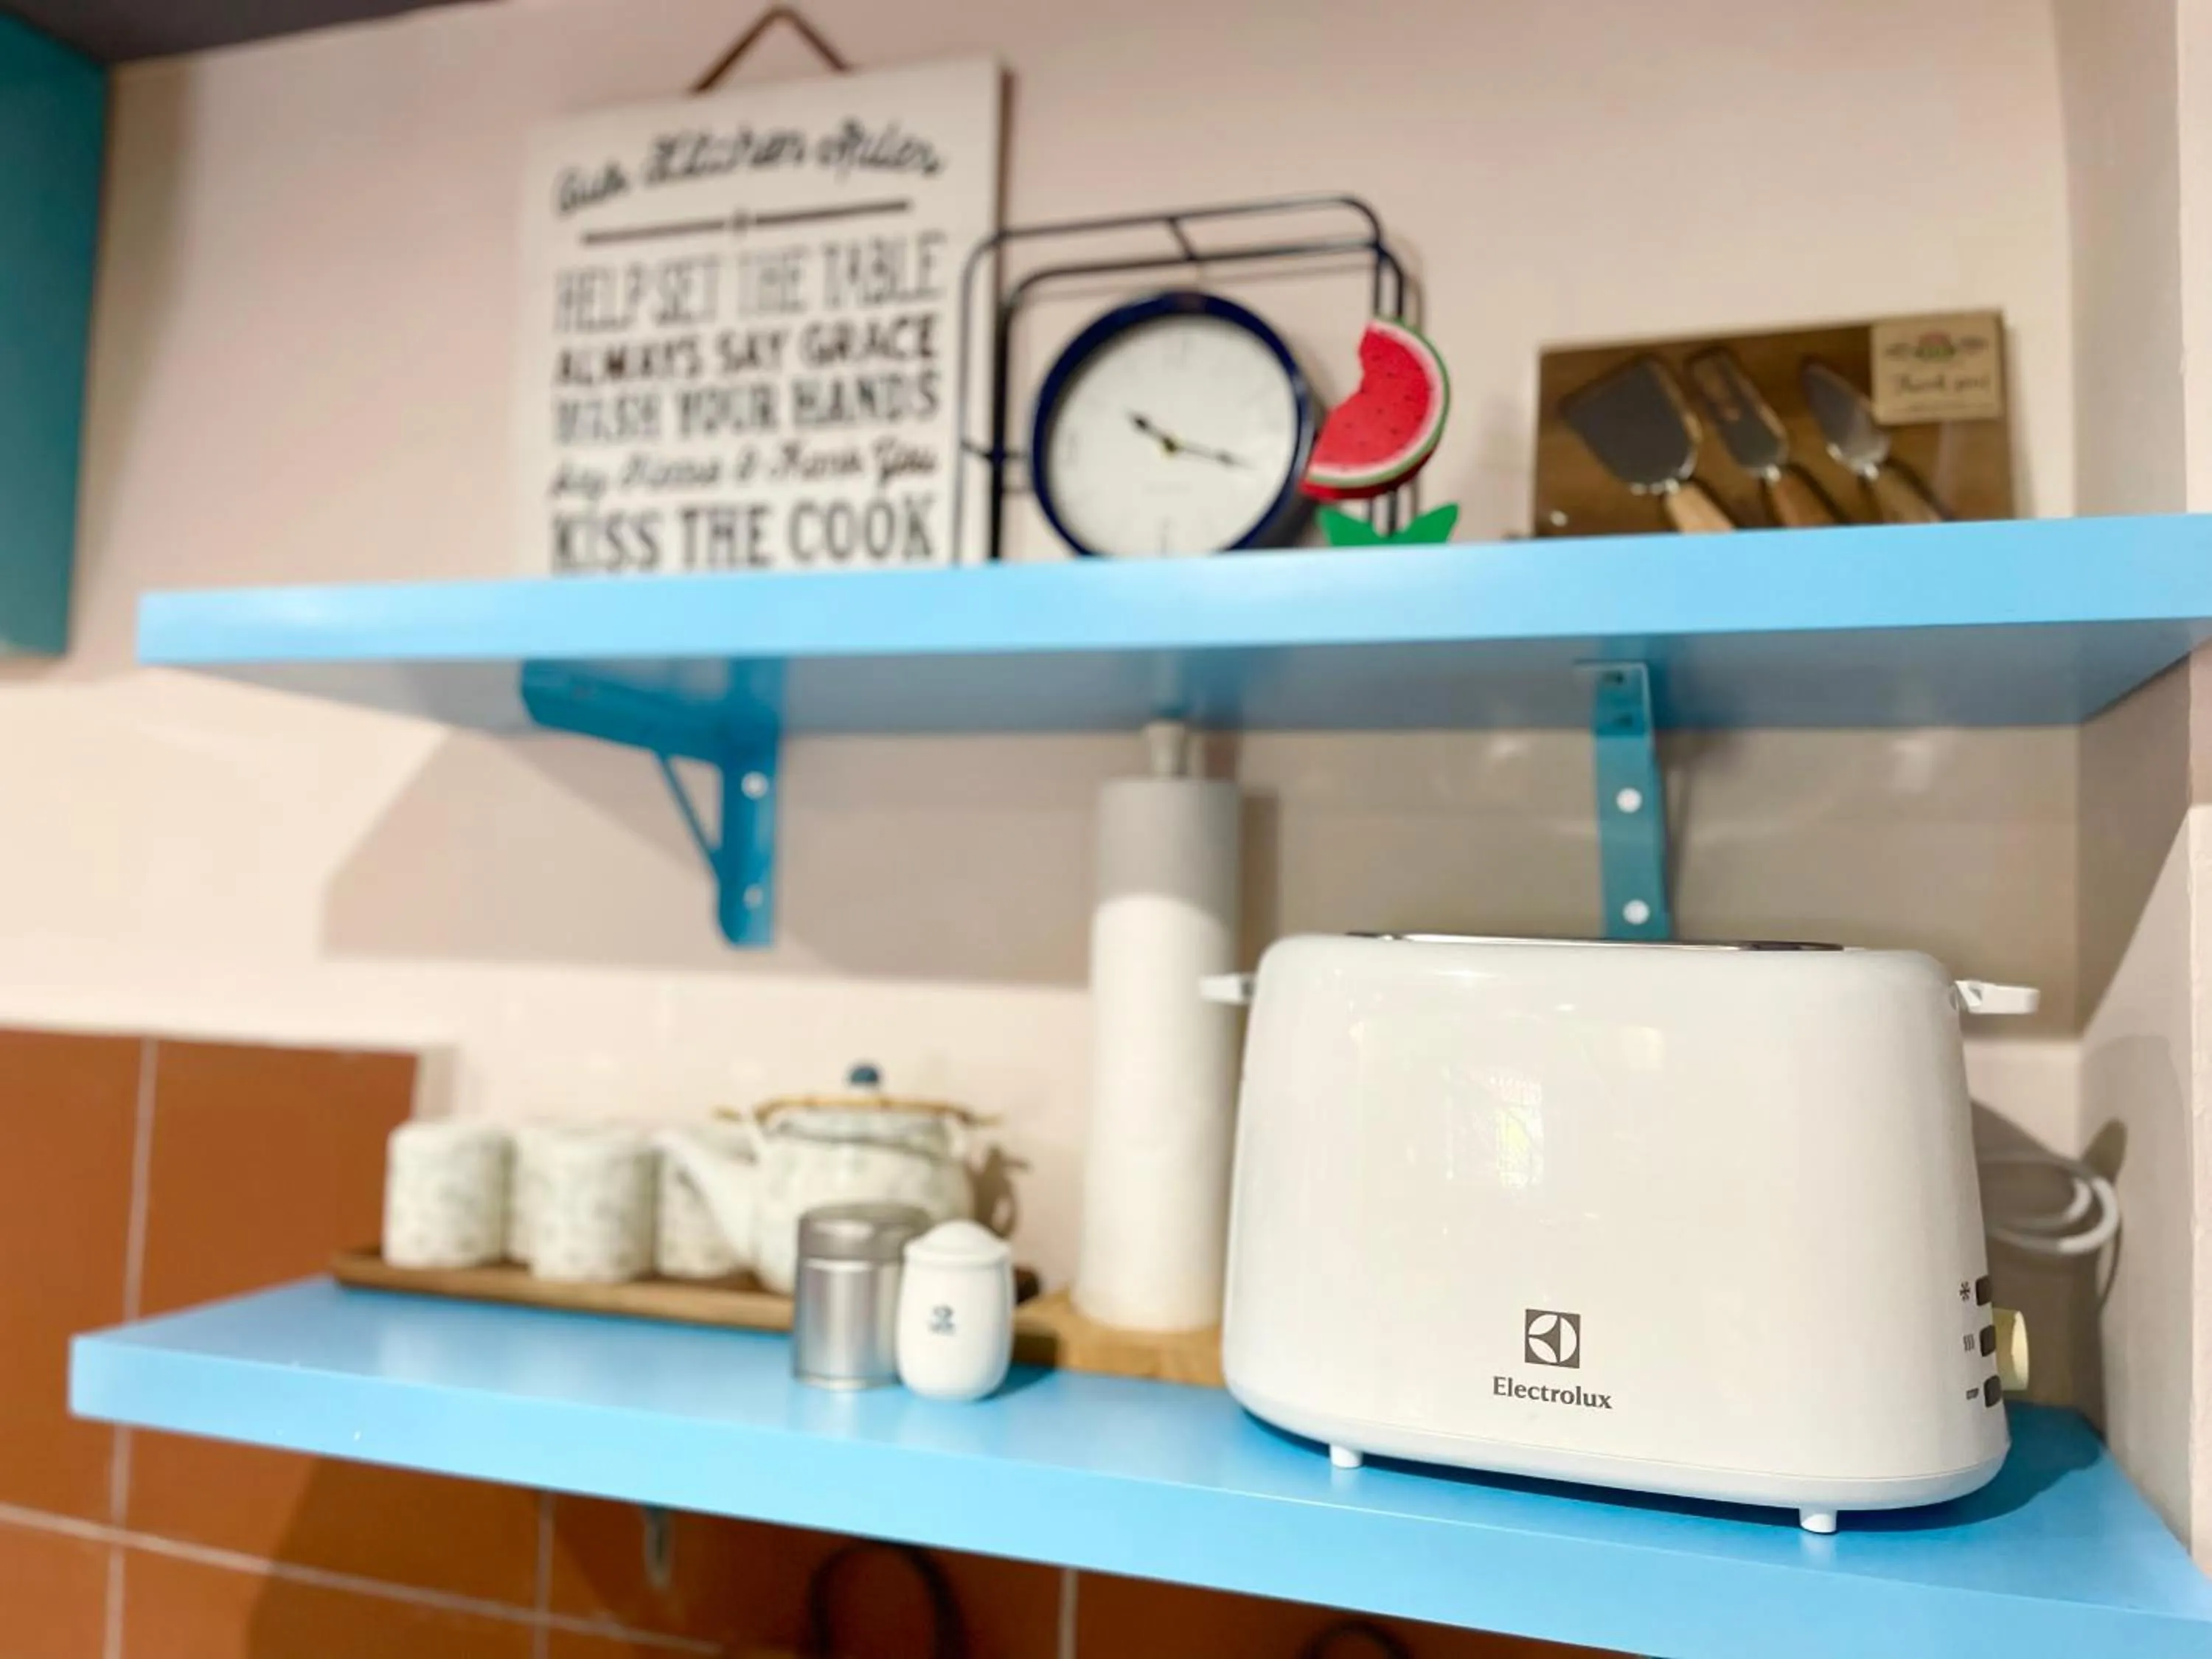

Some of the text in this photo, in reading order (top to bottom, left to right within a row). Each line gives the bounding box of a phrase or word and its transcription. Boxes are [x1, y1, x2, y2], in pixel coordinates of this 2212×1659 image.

[554, 231, 947, 332] HELP SET THE TABLE
[554, 313, 939, 386] ALWAYS SAY GRACE
[554, 370, 940, 442] WASH YOUR HANDS
[552, 493, 935, 574] KISS THE COOK
[1492, 1375, 1613, 1410] Electrolux
